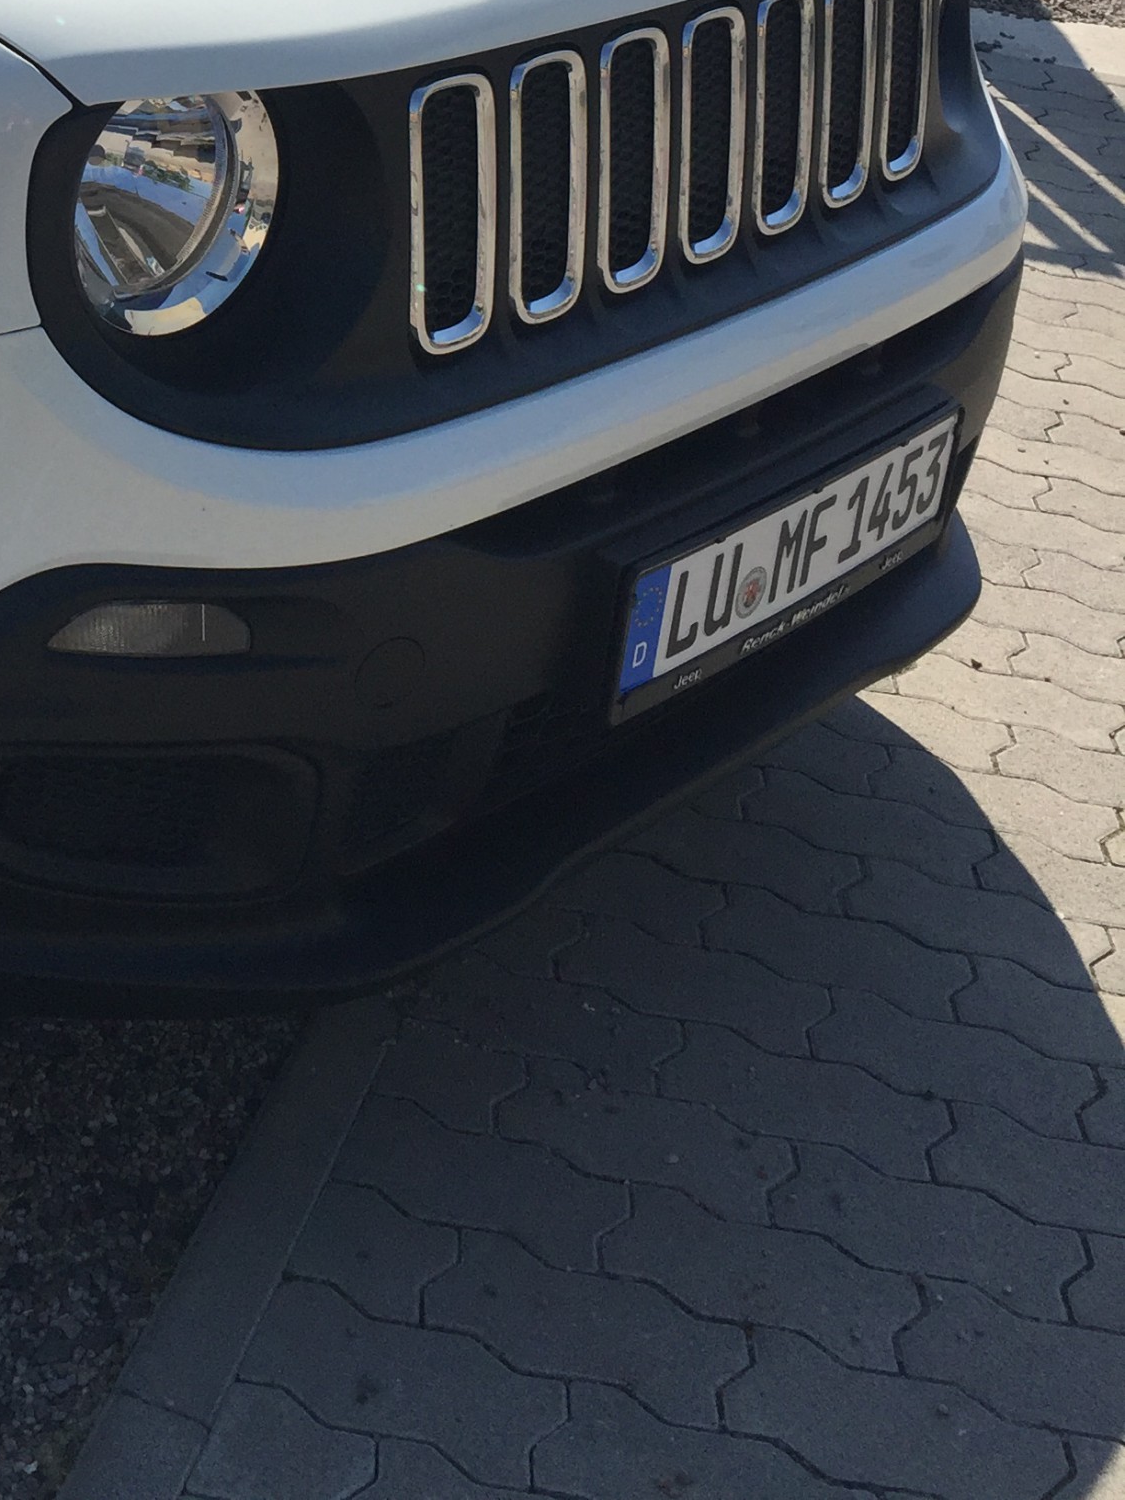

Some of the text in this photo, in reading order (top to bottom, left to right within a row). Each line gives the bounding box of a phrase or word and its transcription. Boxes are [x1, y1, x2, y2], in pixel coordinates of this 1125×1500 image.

[632, 431, 953, 668] D LU MF 1453
[673, 666, 703, 690] Jeep
